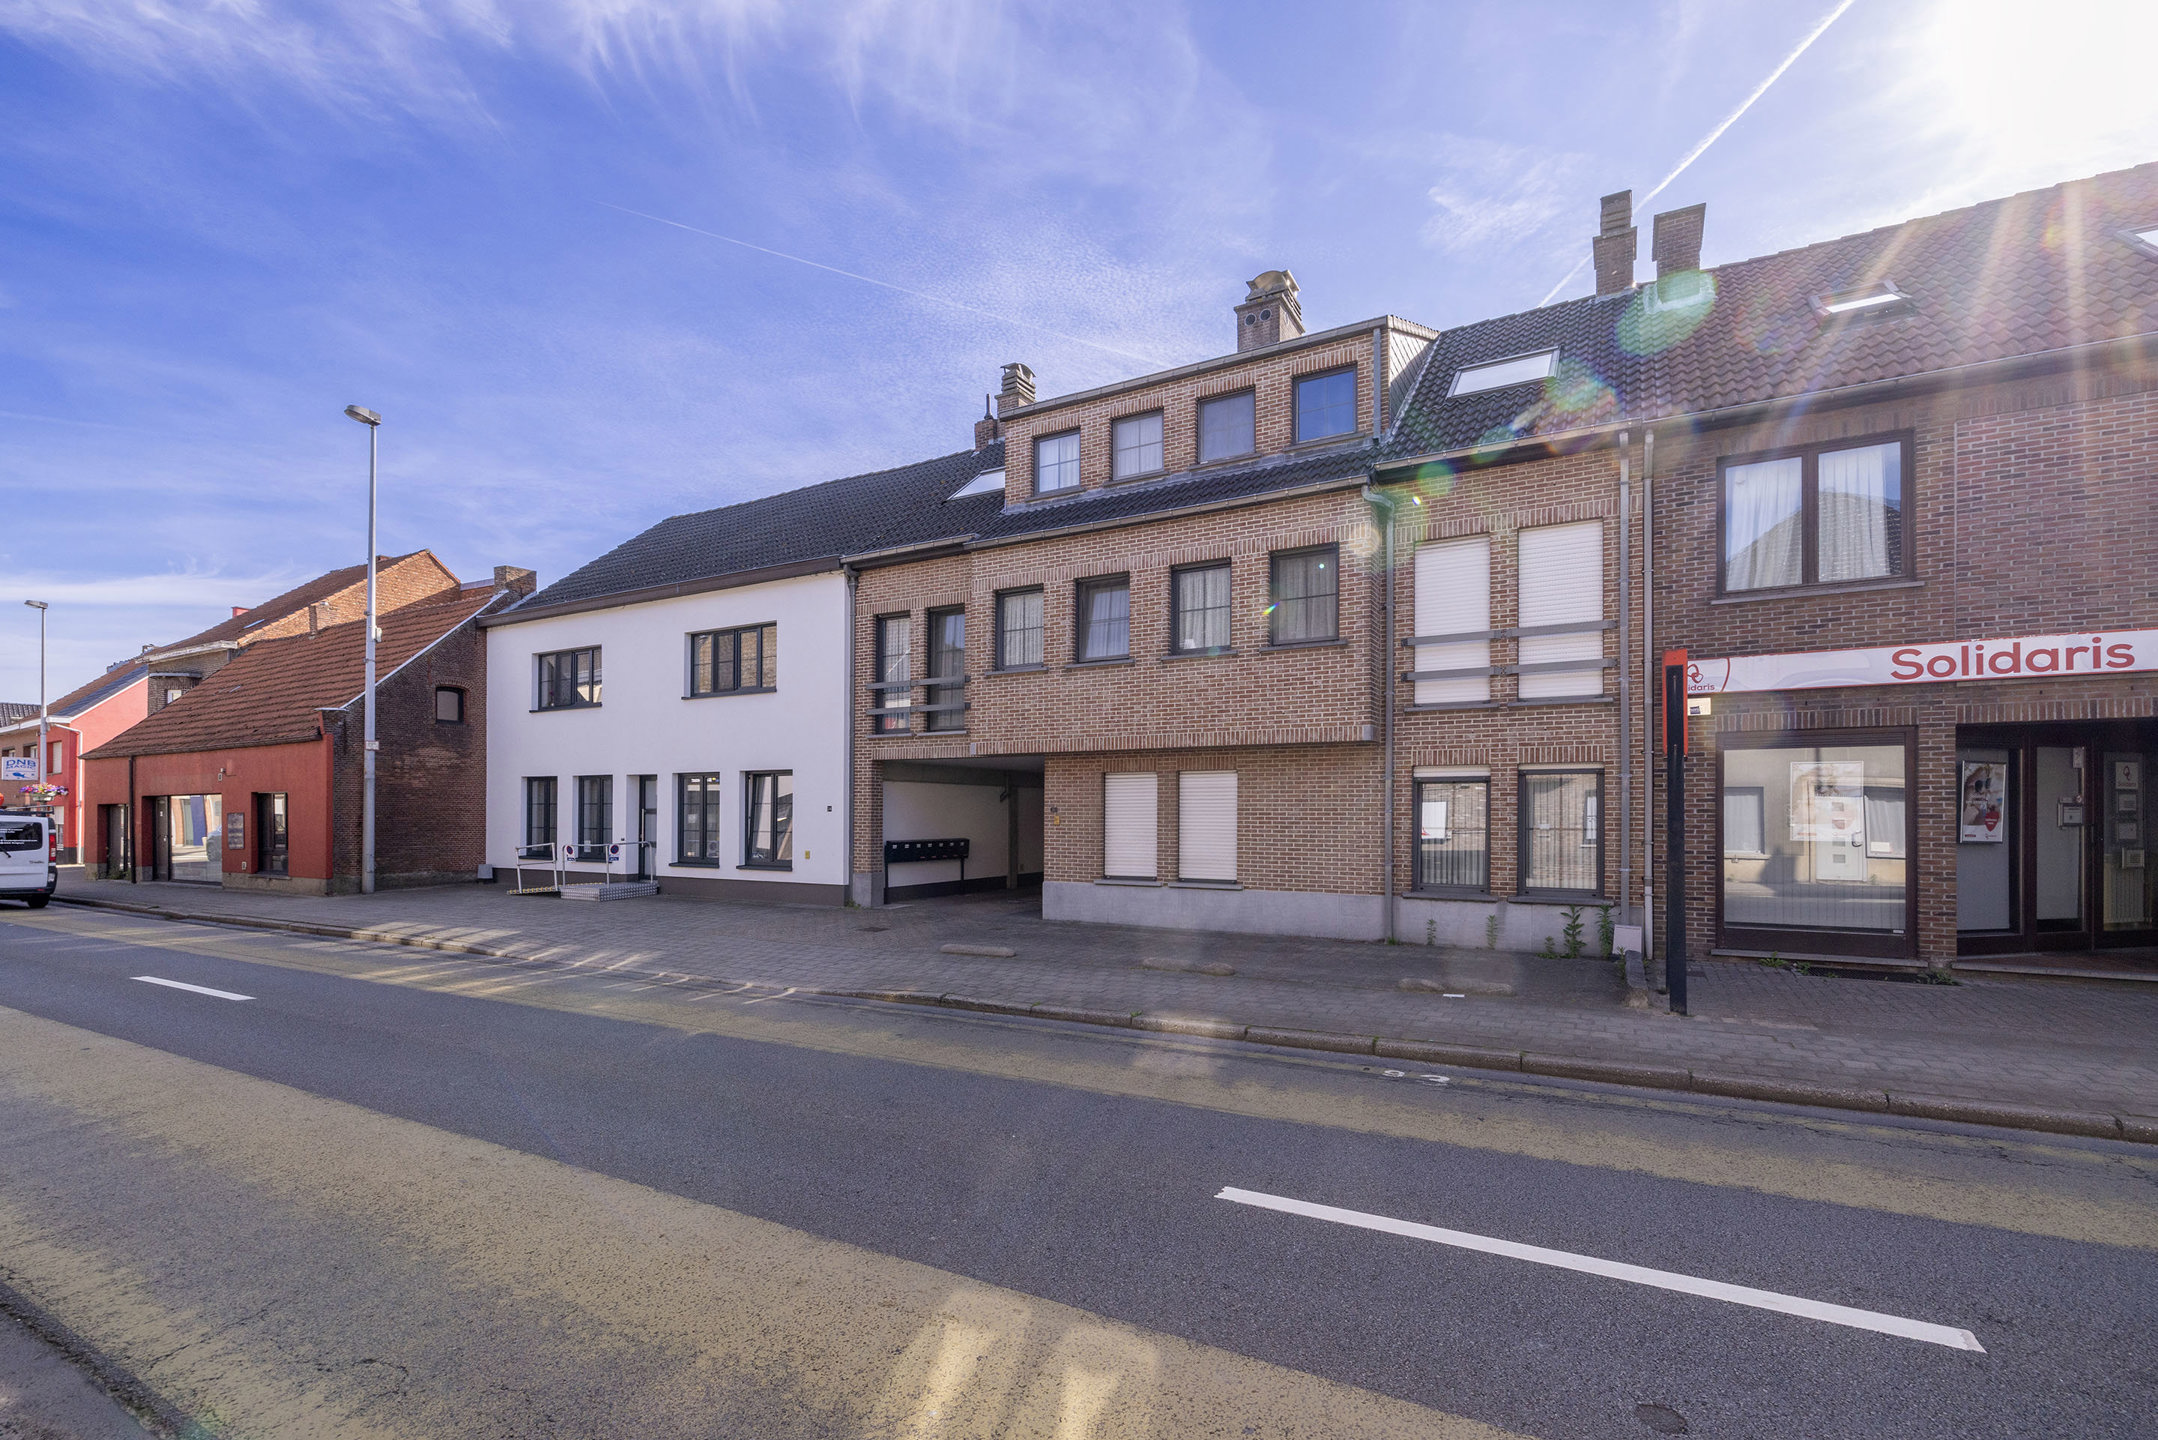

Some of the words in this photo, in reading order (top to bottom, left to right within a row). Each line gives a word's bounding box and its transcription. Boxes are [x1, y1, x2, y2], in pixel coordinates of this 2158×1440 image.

[1890, 636, 2136, 681] Solidaris
[1687, 683, 1715, 691] idaris
[6, 759, 37, 767] DNB
